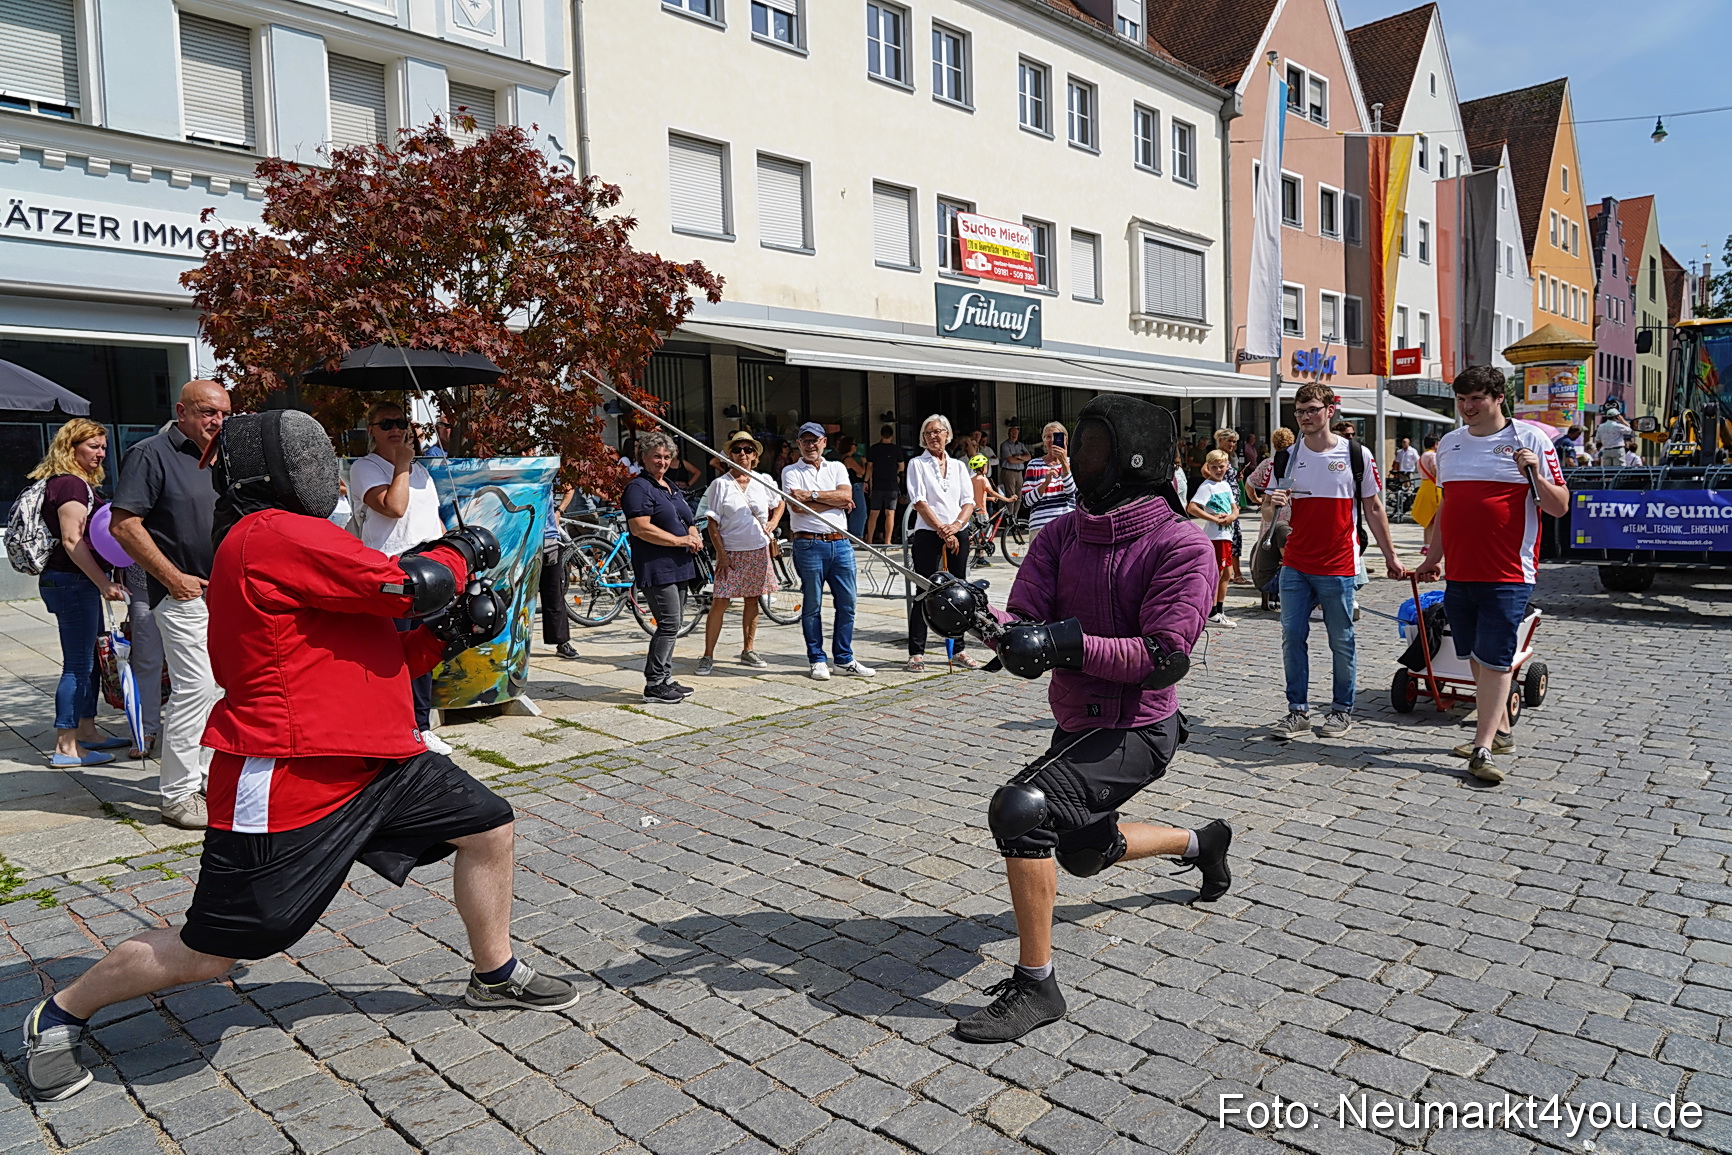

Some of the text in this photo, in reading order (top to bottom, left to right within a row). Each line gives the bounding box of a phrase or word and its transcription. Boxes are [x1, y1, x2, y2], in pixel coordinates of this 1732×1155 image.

[0, 199, 121, 241] ÄTZER
[962, 220, 1031, 246] Suche Mieter!
[993, 266, 1009, 277] 09181
[1013, 270, 1024, 279] 509
[944, 292, 1039, 340] frühauf
[1587, 502, 1640, 518] THW
[1637, 538, 1713, 546] www.thw-neumarkt.de
